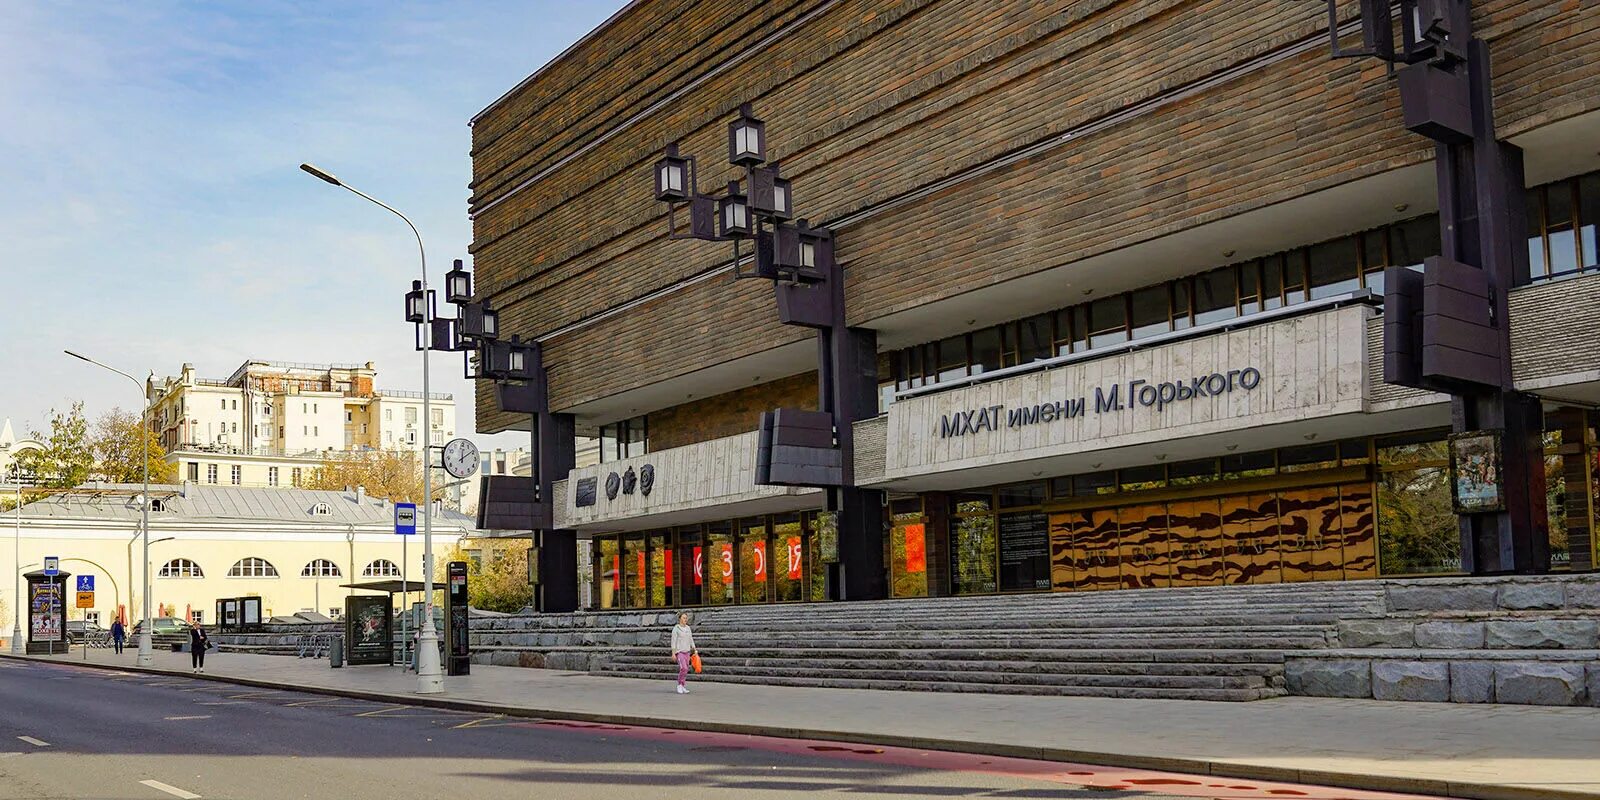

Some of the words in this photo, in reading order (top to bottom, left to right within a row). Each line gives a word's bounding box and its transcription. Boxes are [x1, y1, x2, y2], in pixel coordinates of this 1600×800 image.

[940, 404, 1004, 439] МХАТ
[1007, 397, 1085, 428] имени
[1094, 367, 1261, 415] М.Горького
